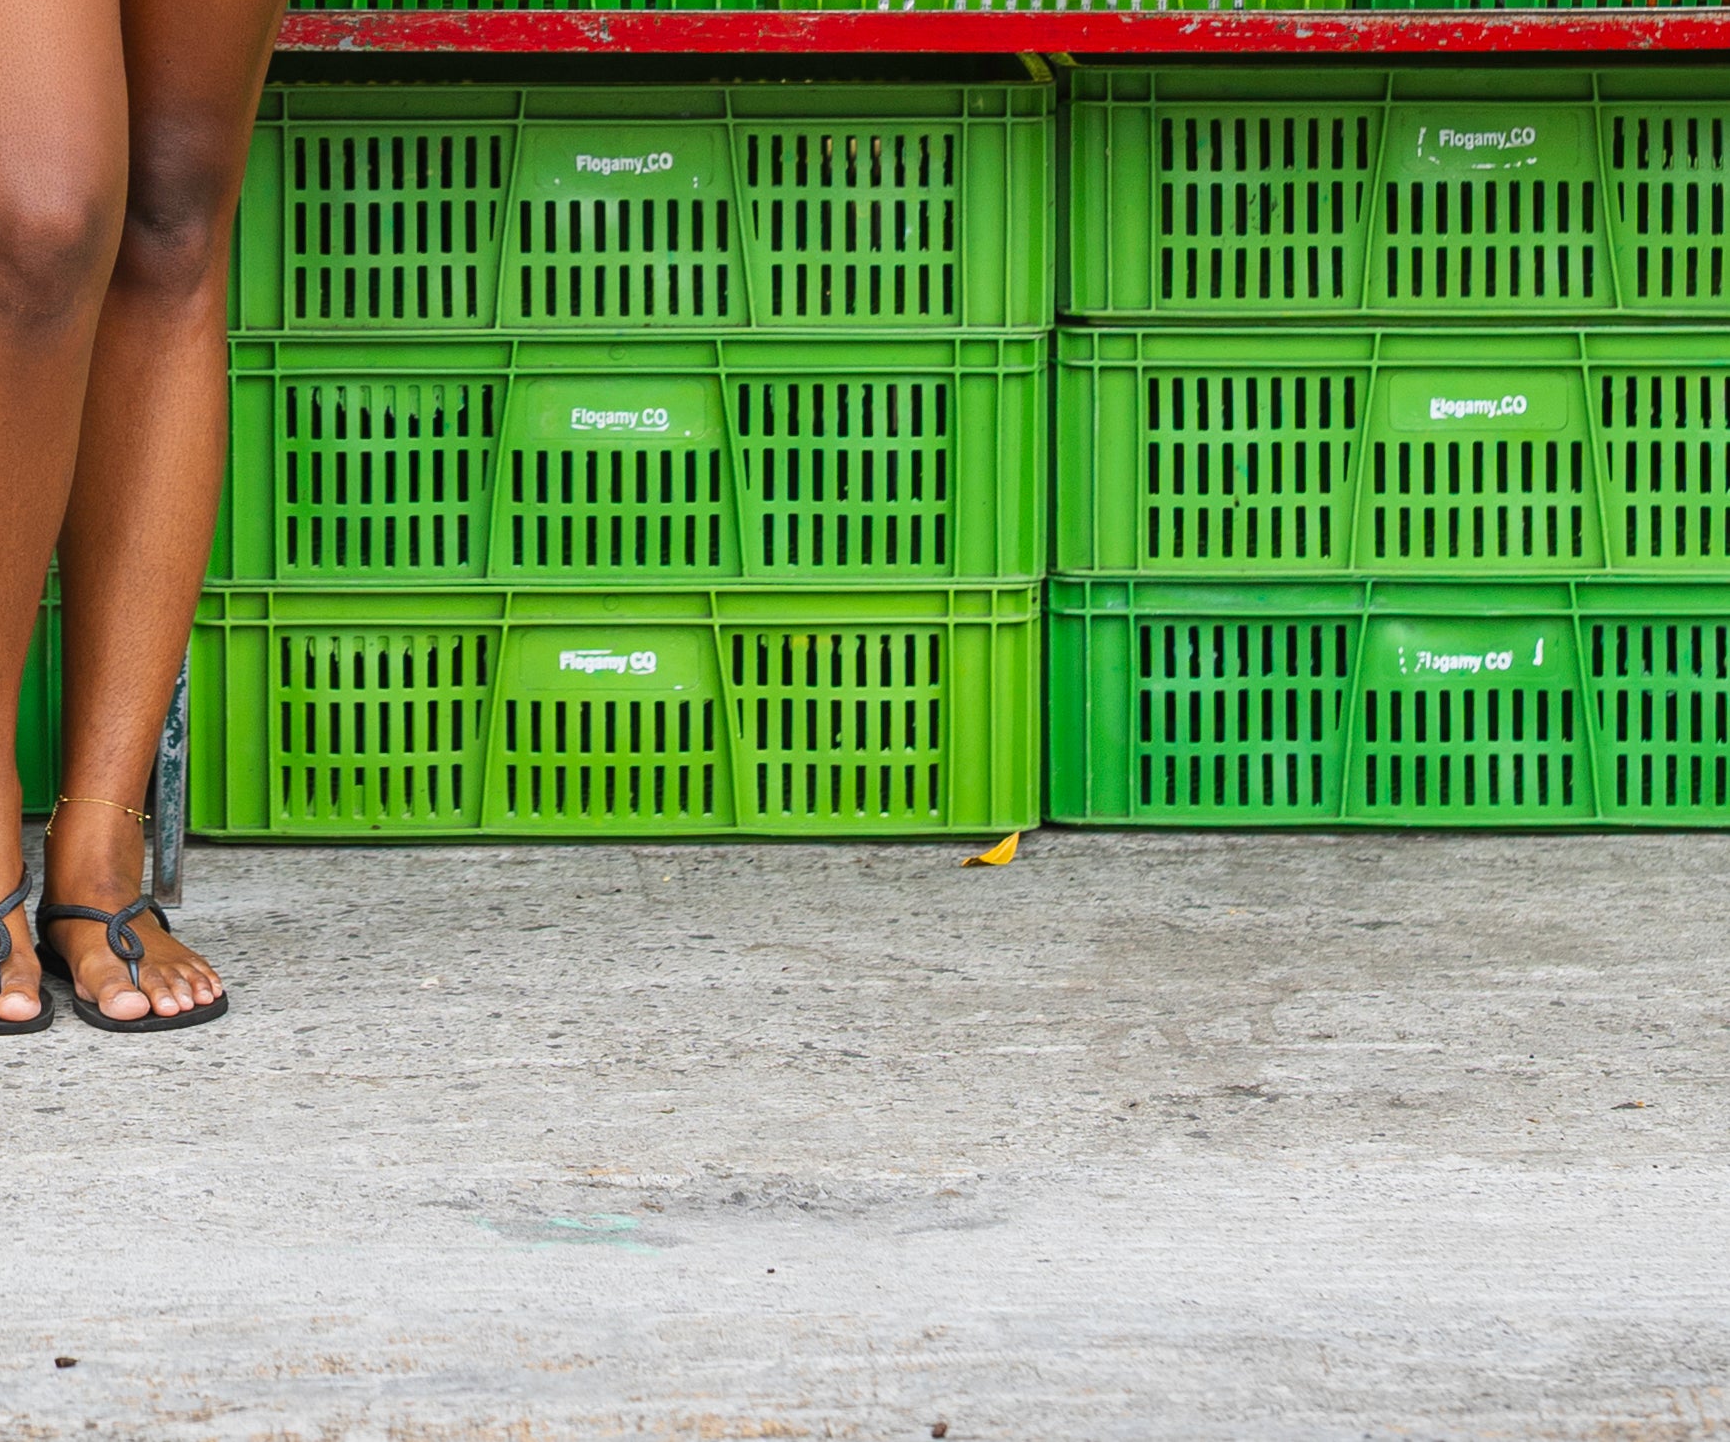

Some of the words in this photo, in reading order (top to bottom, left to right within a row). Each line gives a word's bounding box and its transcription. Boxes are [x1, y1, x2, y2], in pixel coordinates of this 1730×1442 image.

[1438, 128, 1506, 151] Flogamy
[1510, 126, 1536, 146] CO
[575, 154, 644, 176] Flogamy
[646, 152, 673, 171] CO
[1500, 394, 1528, 415] CO
[571, 407, 639, 430] Flogamy
[641, 407, 668, 426] CO
[559, 649, 628, 675] Flogamy
[629, 651, 657, 672] CO
[1484, 651, 1513, 671] CO
